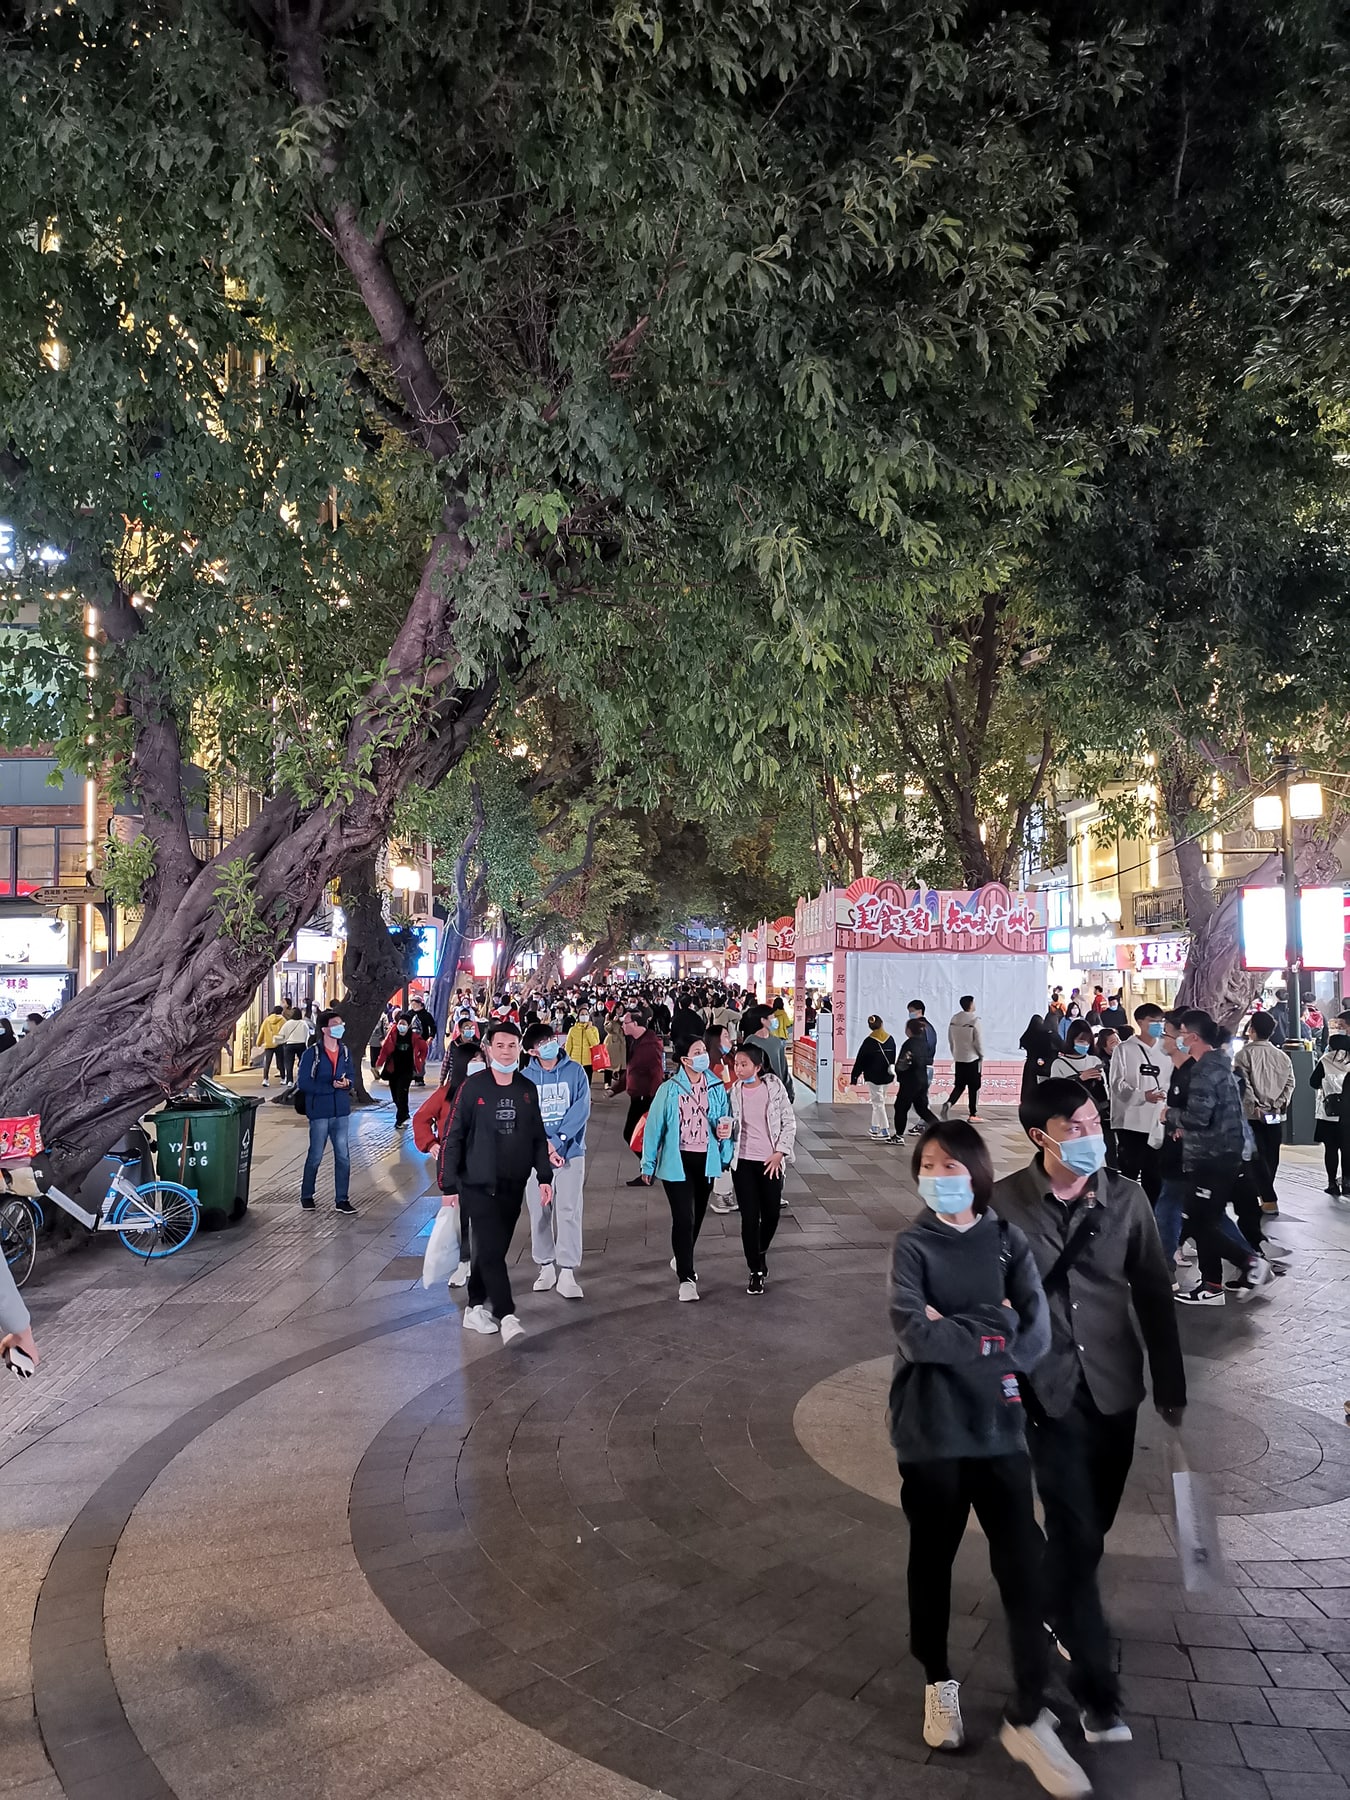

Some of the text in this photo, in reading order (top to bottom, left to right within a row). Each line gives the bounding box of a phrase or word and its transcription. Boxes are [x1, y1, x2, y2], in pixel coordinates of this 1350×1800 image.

[946, 901, 1031, 933] 知味广州
[836, 974, 846, 1036] 品一方美食
